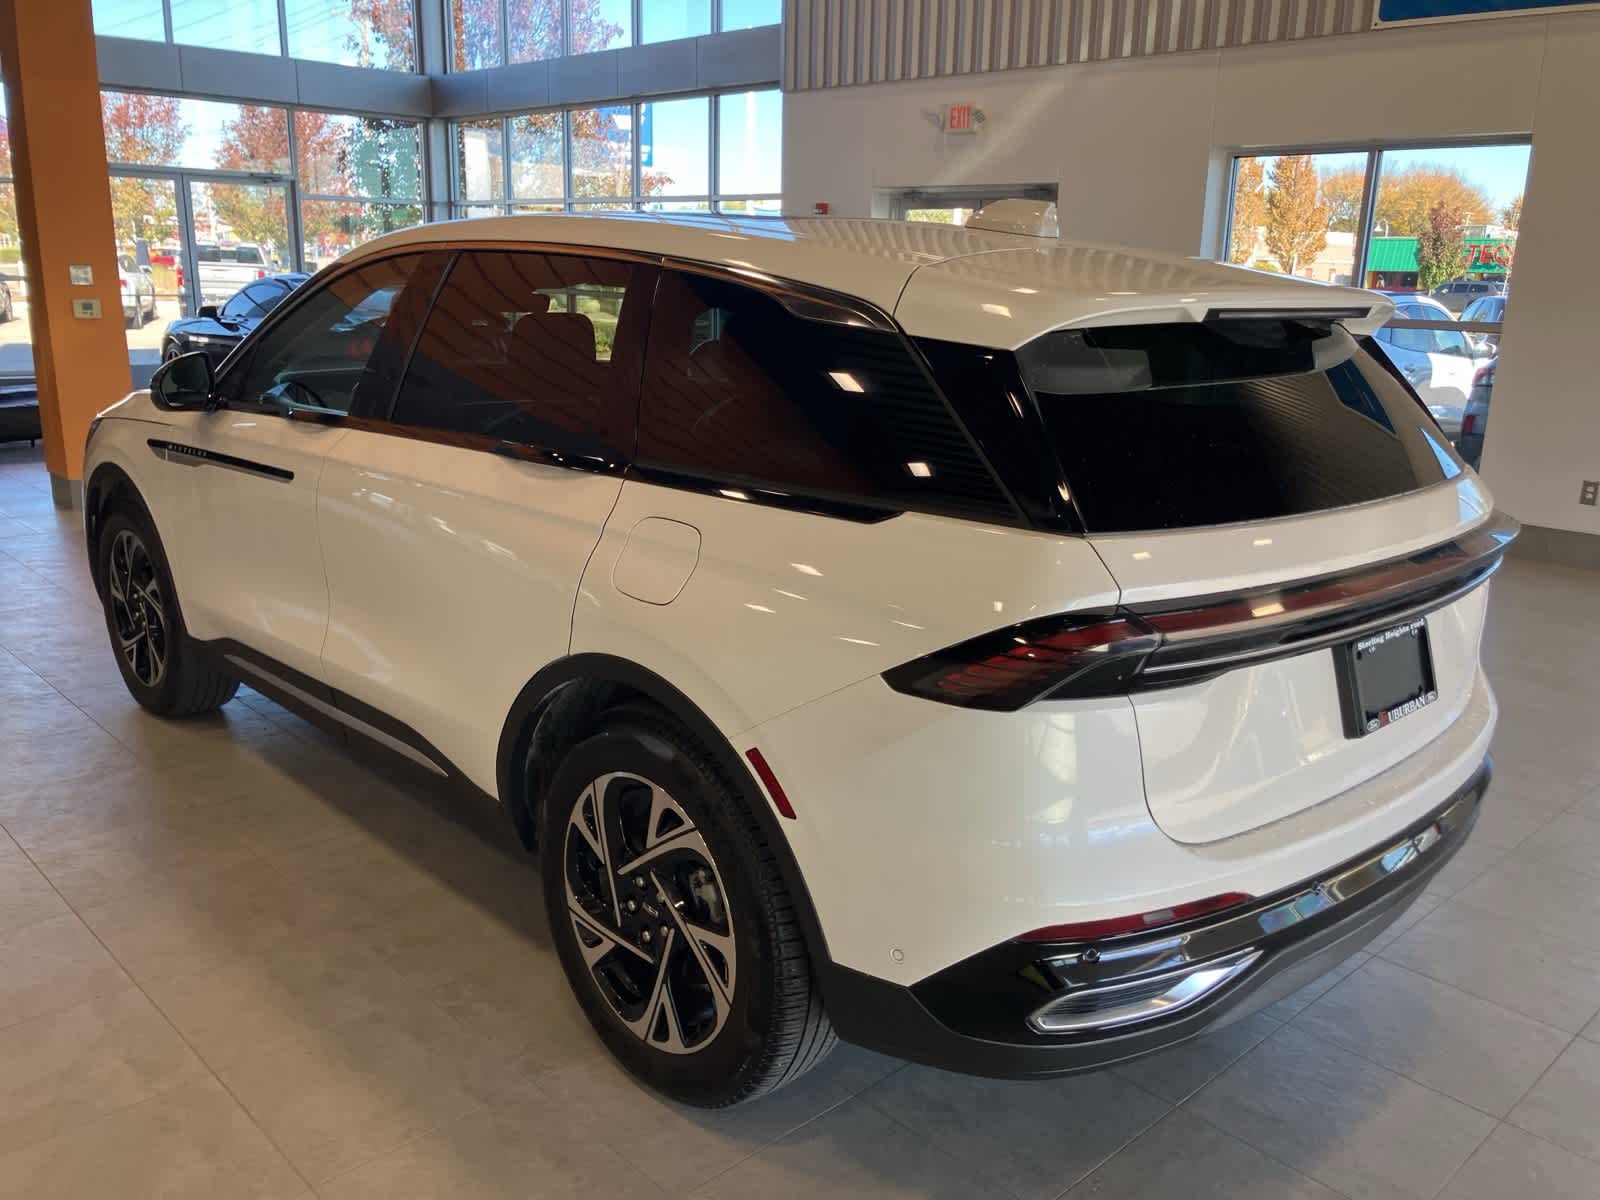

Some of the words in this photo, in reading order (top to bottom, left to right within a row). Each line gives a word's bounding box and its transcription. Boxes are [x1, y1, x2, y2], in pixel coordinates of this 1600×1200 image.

[948, 104, 971, 128] EXIT
[1357, 635, 1385, 650] Sterling
[1385, 625, 1410, 640] Heights
